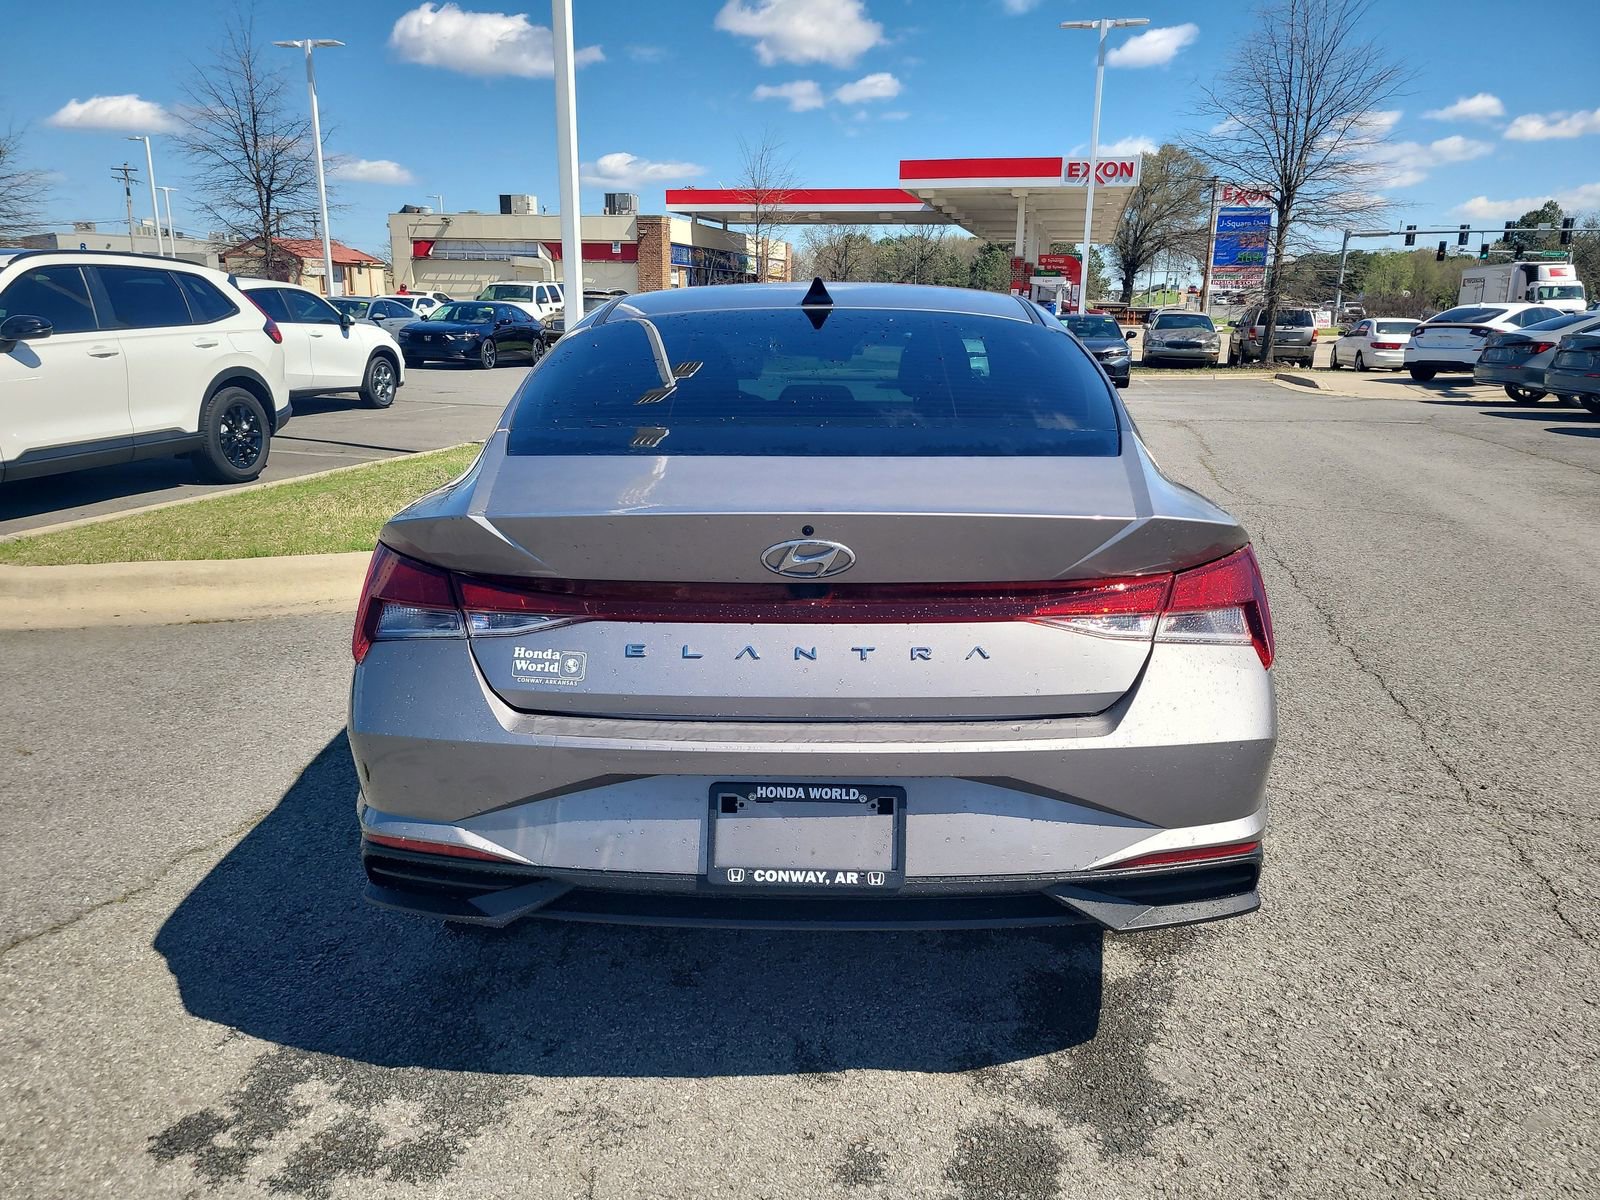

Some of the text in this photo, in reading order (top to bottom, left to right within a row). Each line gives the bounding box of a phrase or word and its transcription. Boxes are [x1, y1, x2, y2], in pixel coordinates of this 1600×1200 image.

[1067, 161, 1134, 184] EXXON
[513, 646, 560, 660] Honda
[625, 644, 990, 661] ELANTRA
[515, 659, 559, 673] World
[517, 677, 578, 687] CONWAY, ARKANSAS
[756, 786, 860, 800] HONDA WORLD
[753, 869, 858, 885] CONWAY, AR
